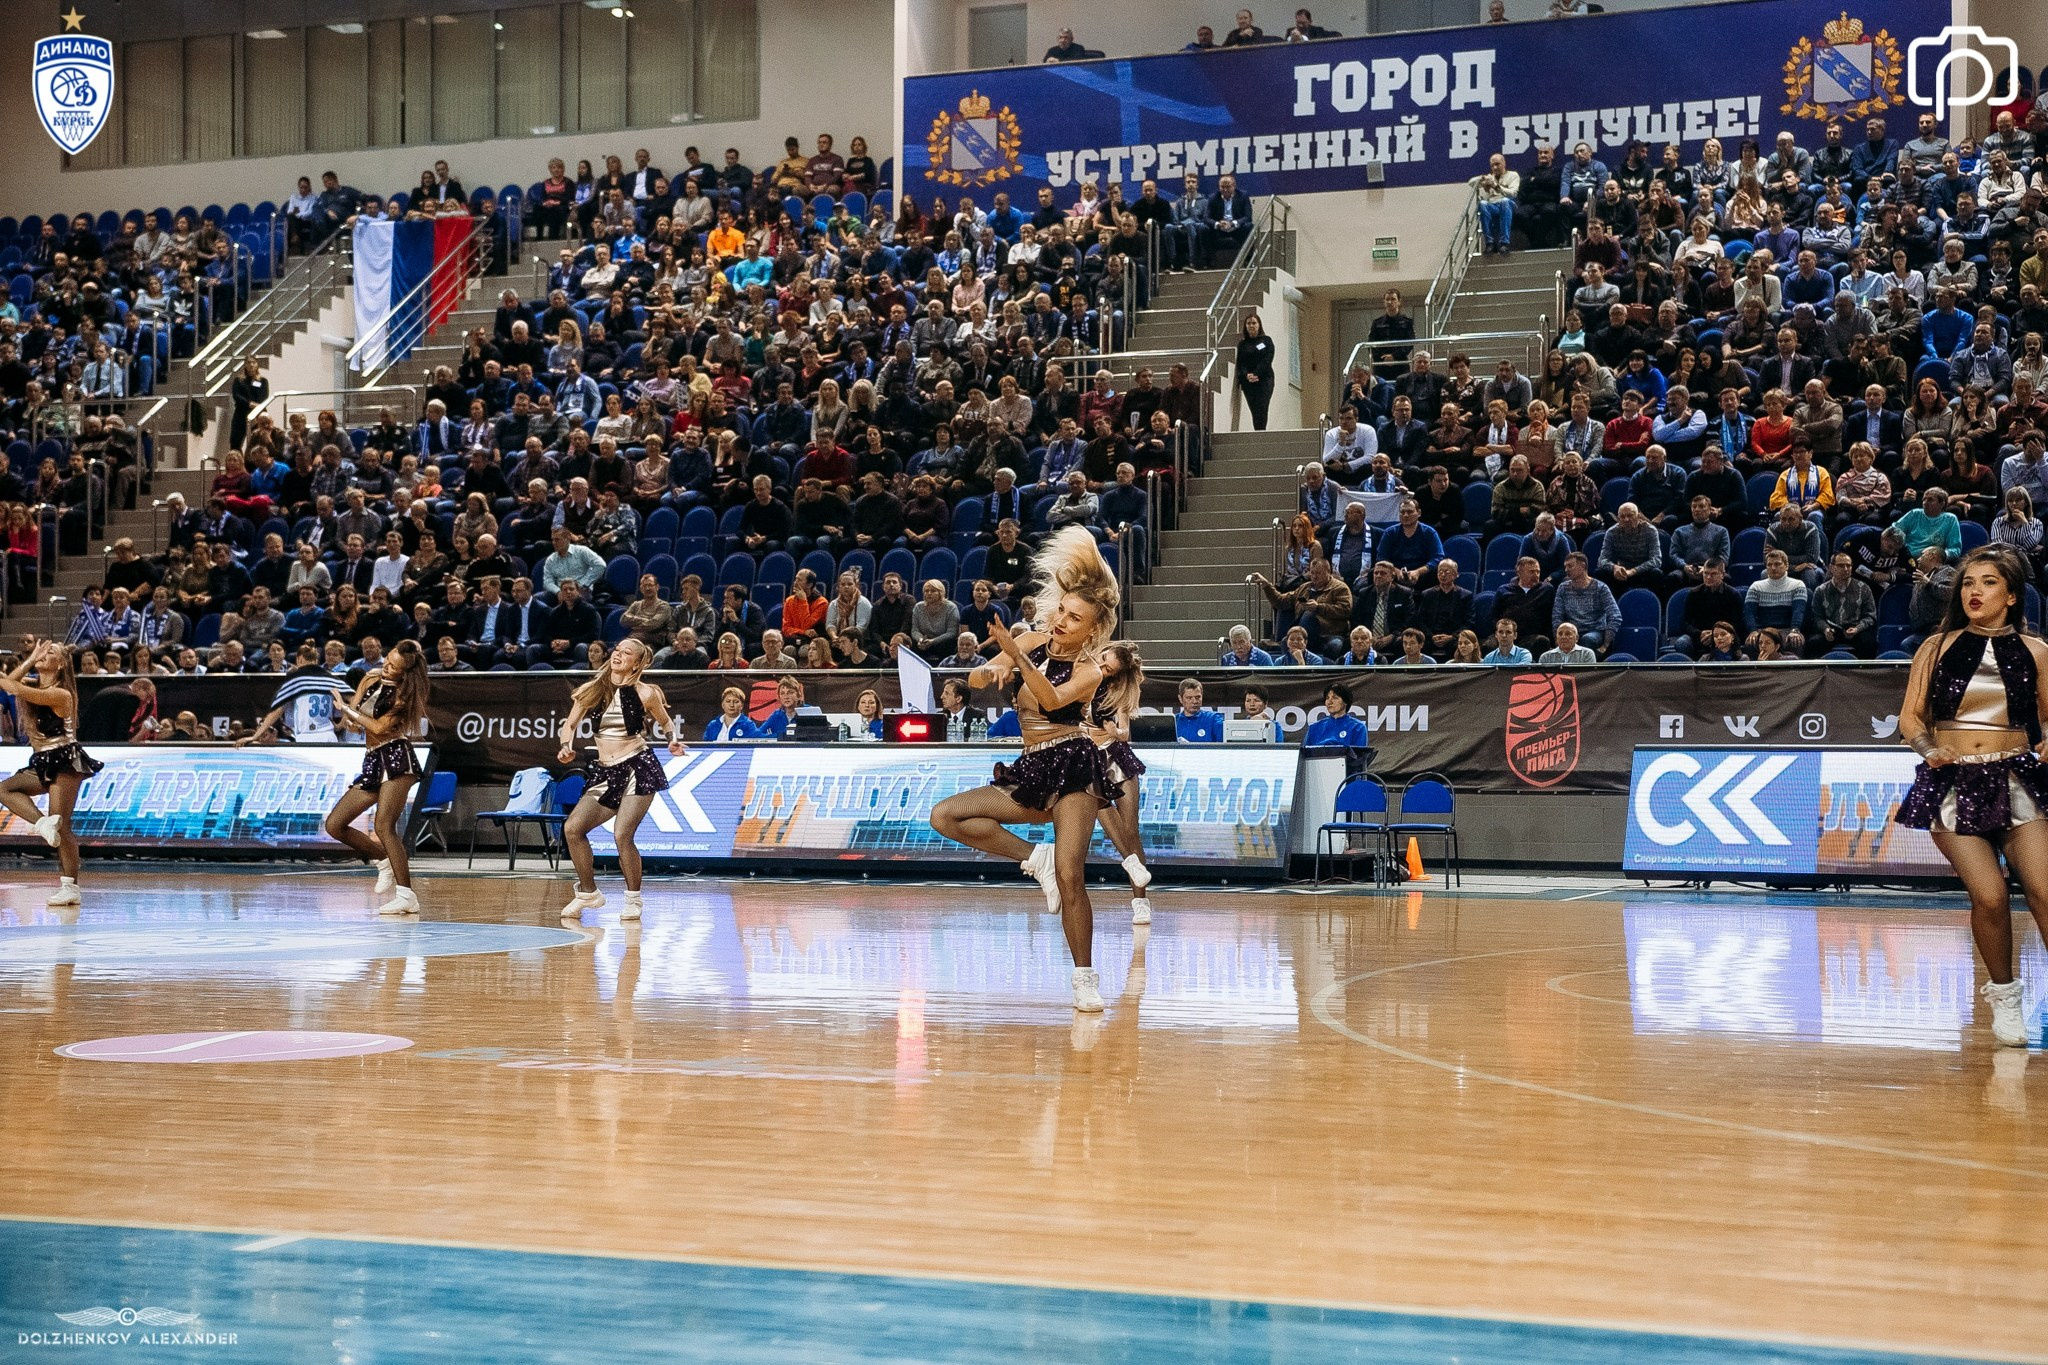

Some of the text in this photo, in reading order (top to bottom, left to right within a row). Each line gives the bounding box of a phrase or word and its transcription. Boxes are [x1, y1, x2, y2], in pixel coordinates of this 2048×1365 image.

[1293, 49, 1496, 116] ГОРОД
[1045, 95, 1762, 188] УСТРЕМЛЕННЫЙ В БУДУЩЕЕ!
[308, 695, 330, 718] 33
[1516, 731, 1577, 760] ПРЕМЬЕР-
[1526, 747, 1567, 775] ЛИГА
[137, 770, 243, 818] ДРУГ
[744, 763, 940, 821] ЛУЧШИЙ
